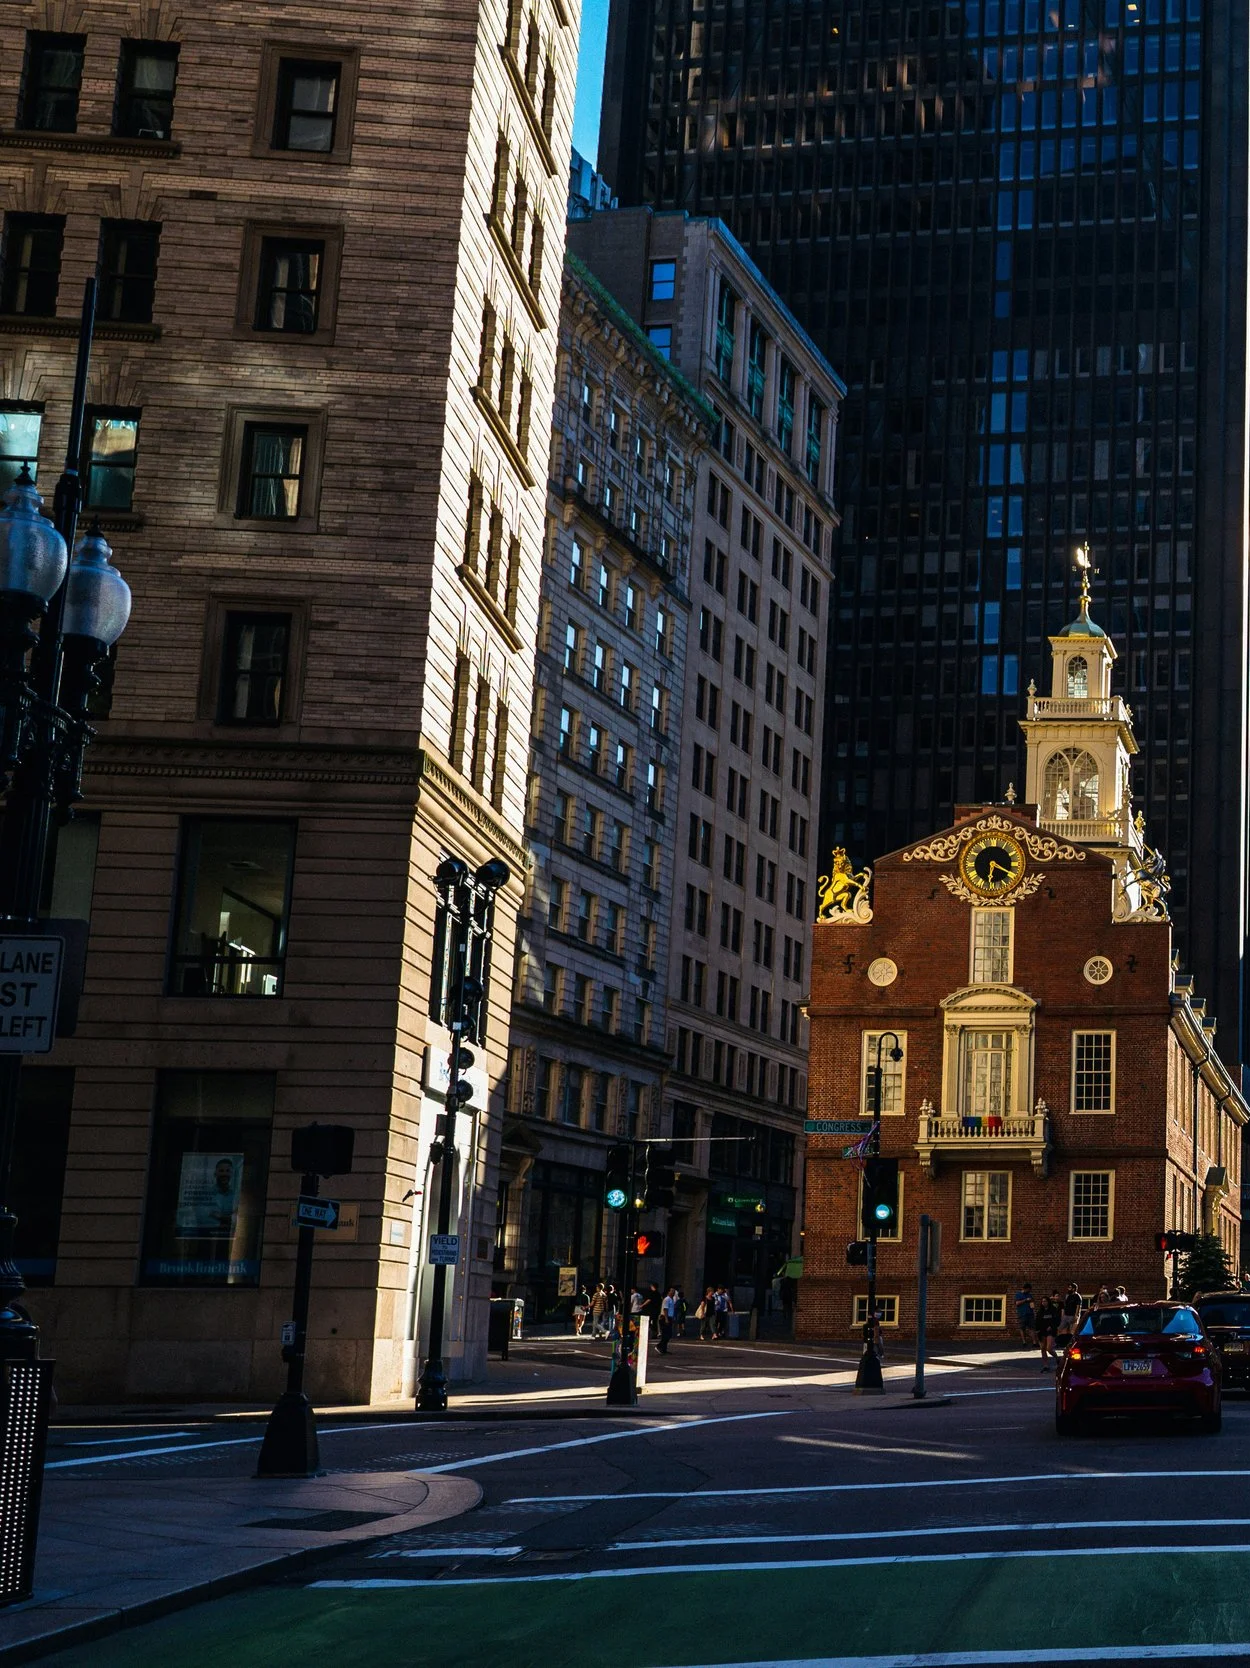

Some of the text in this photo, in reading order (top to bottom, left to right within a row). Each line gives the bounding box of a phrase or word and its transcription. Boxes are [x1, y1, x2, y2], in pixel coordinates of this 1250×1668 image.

[0, 952, 54, 974] LANE
[816, 1121, 862, 1132] CONGRESS
[301, 1205, 326, 1219] ONE WAY
[433, 1237, 457, 1246] YIELD
